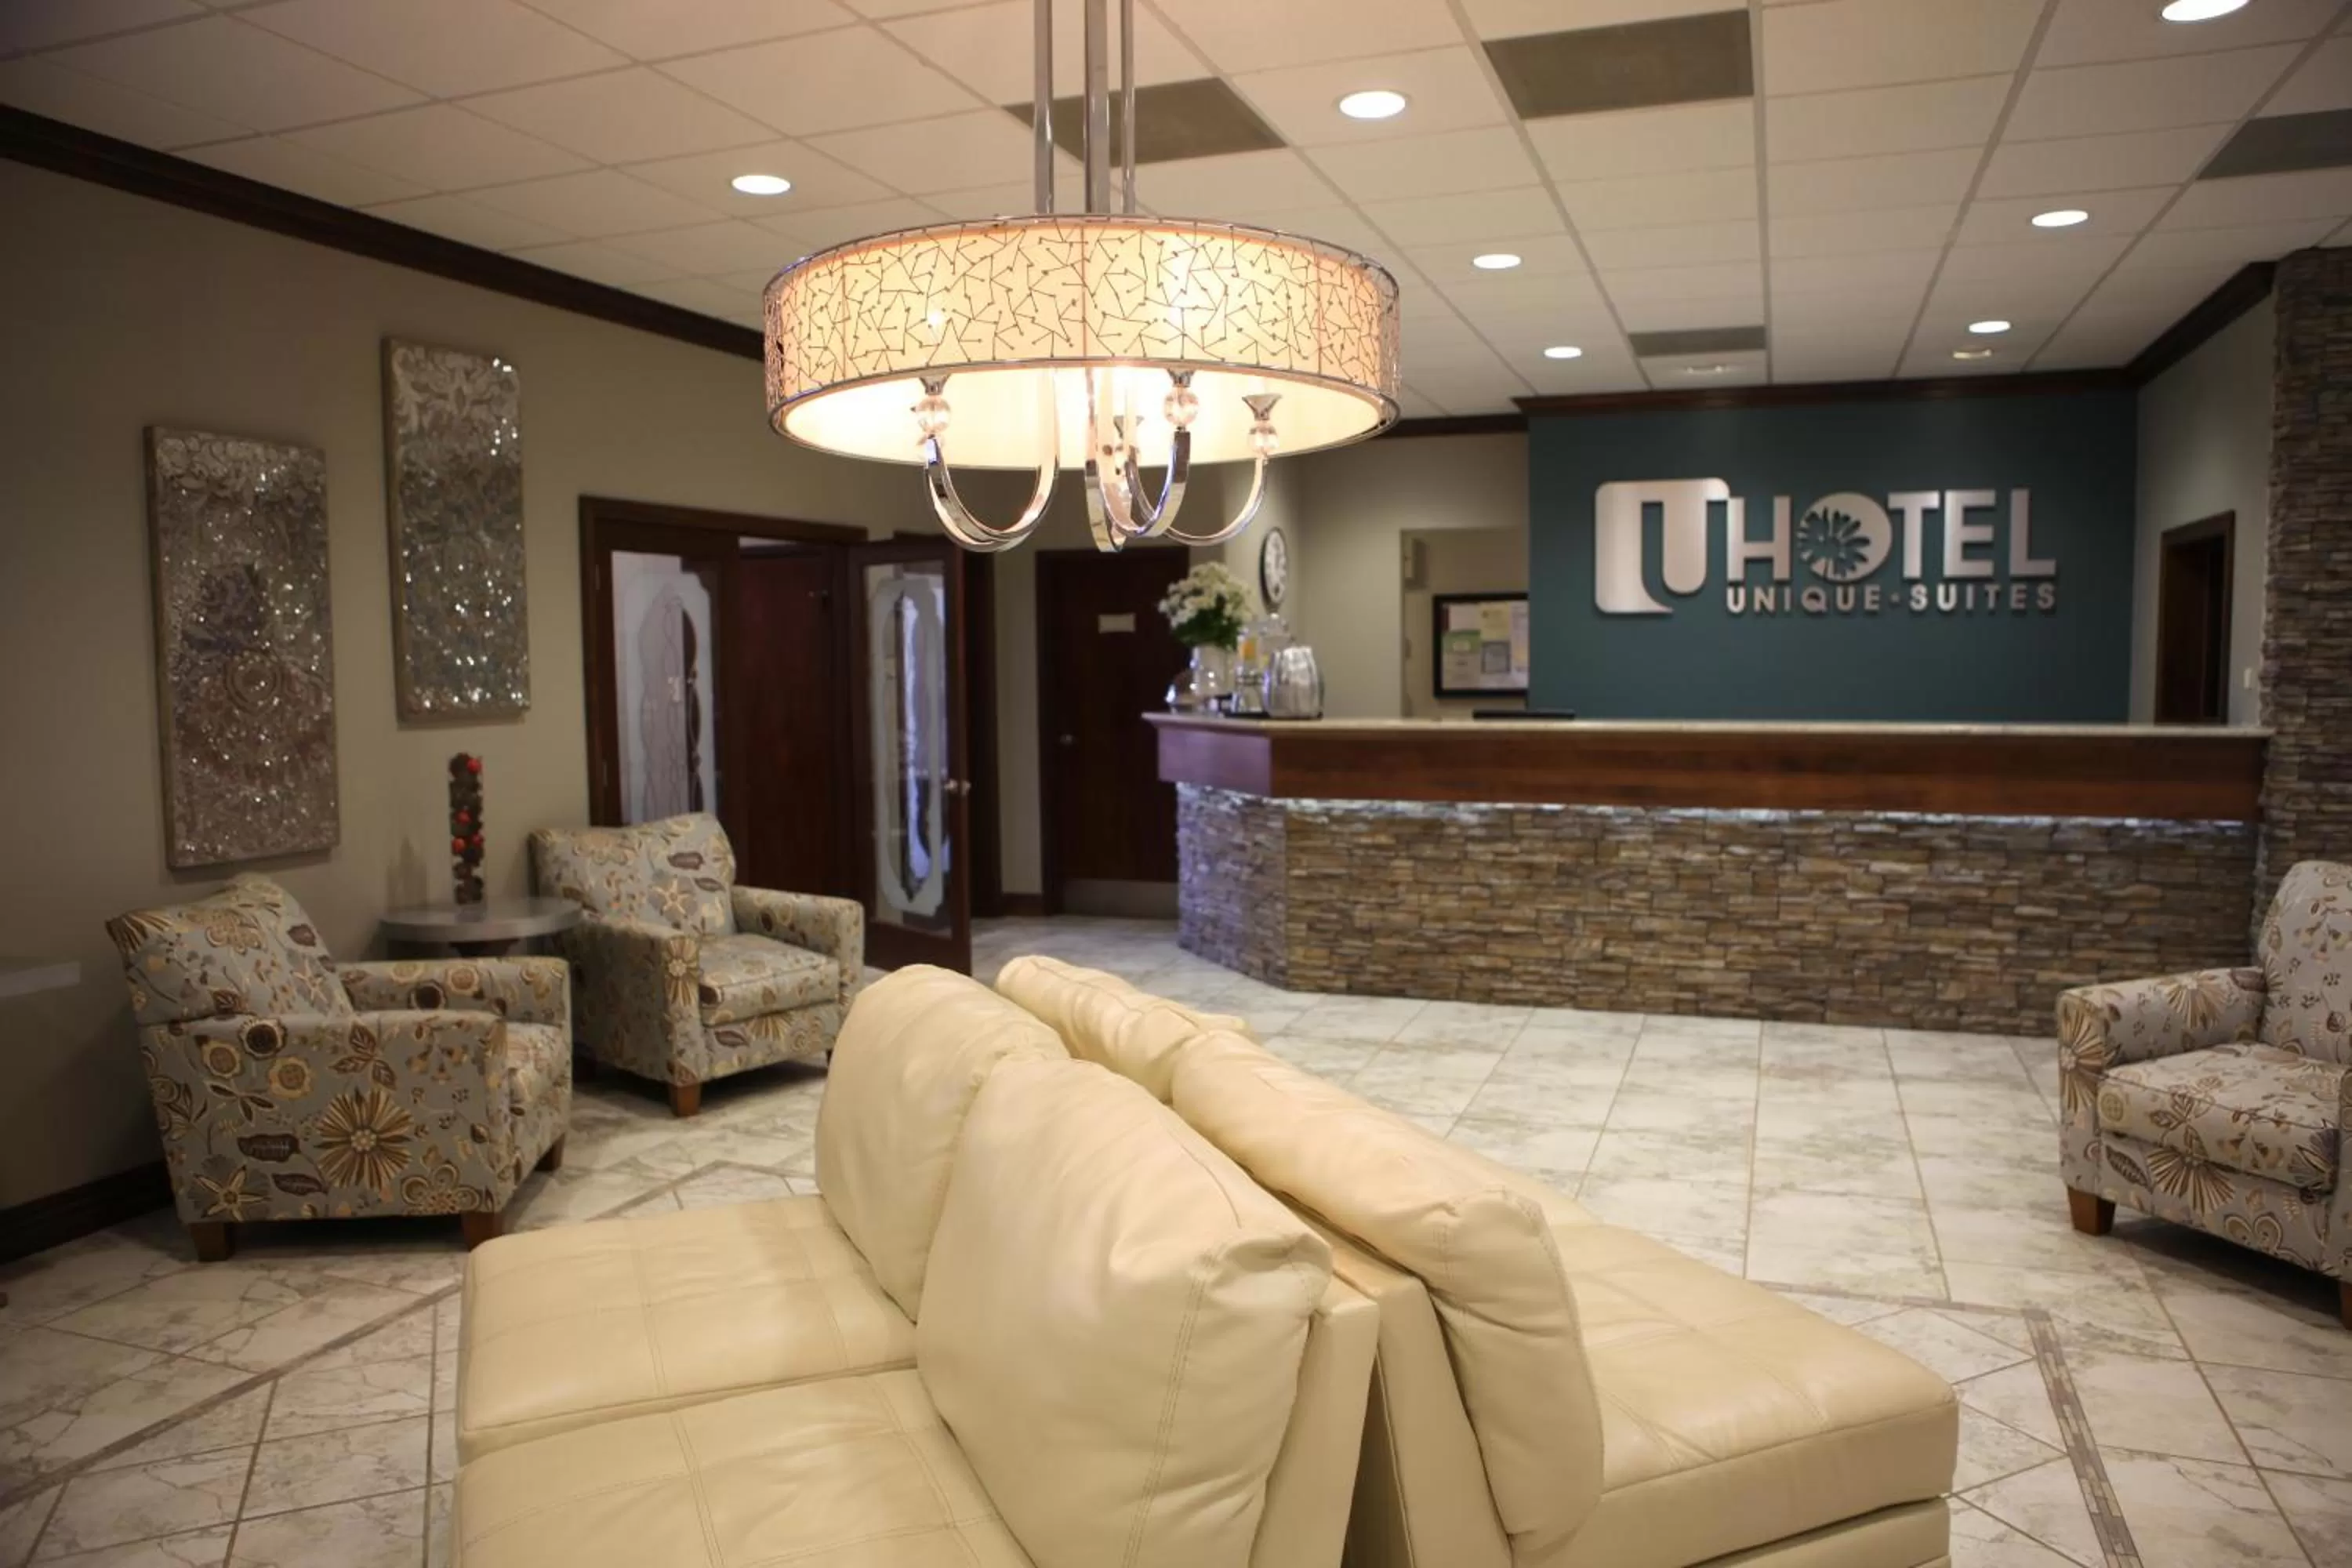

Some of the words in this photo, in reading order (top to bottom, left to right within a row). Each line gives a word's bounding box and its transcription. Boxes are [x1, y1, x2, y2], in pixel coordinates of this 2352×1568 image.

[1727, 488, 2057, 582] HOTEL
[1726, 583, 1882, 614] UNIQUE
[1908, 582, 2056, 611] SUITES
